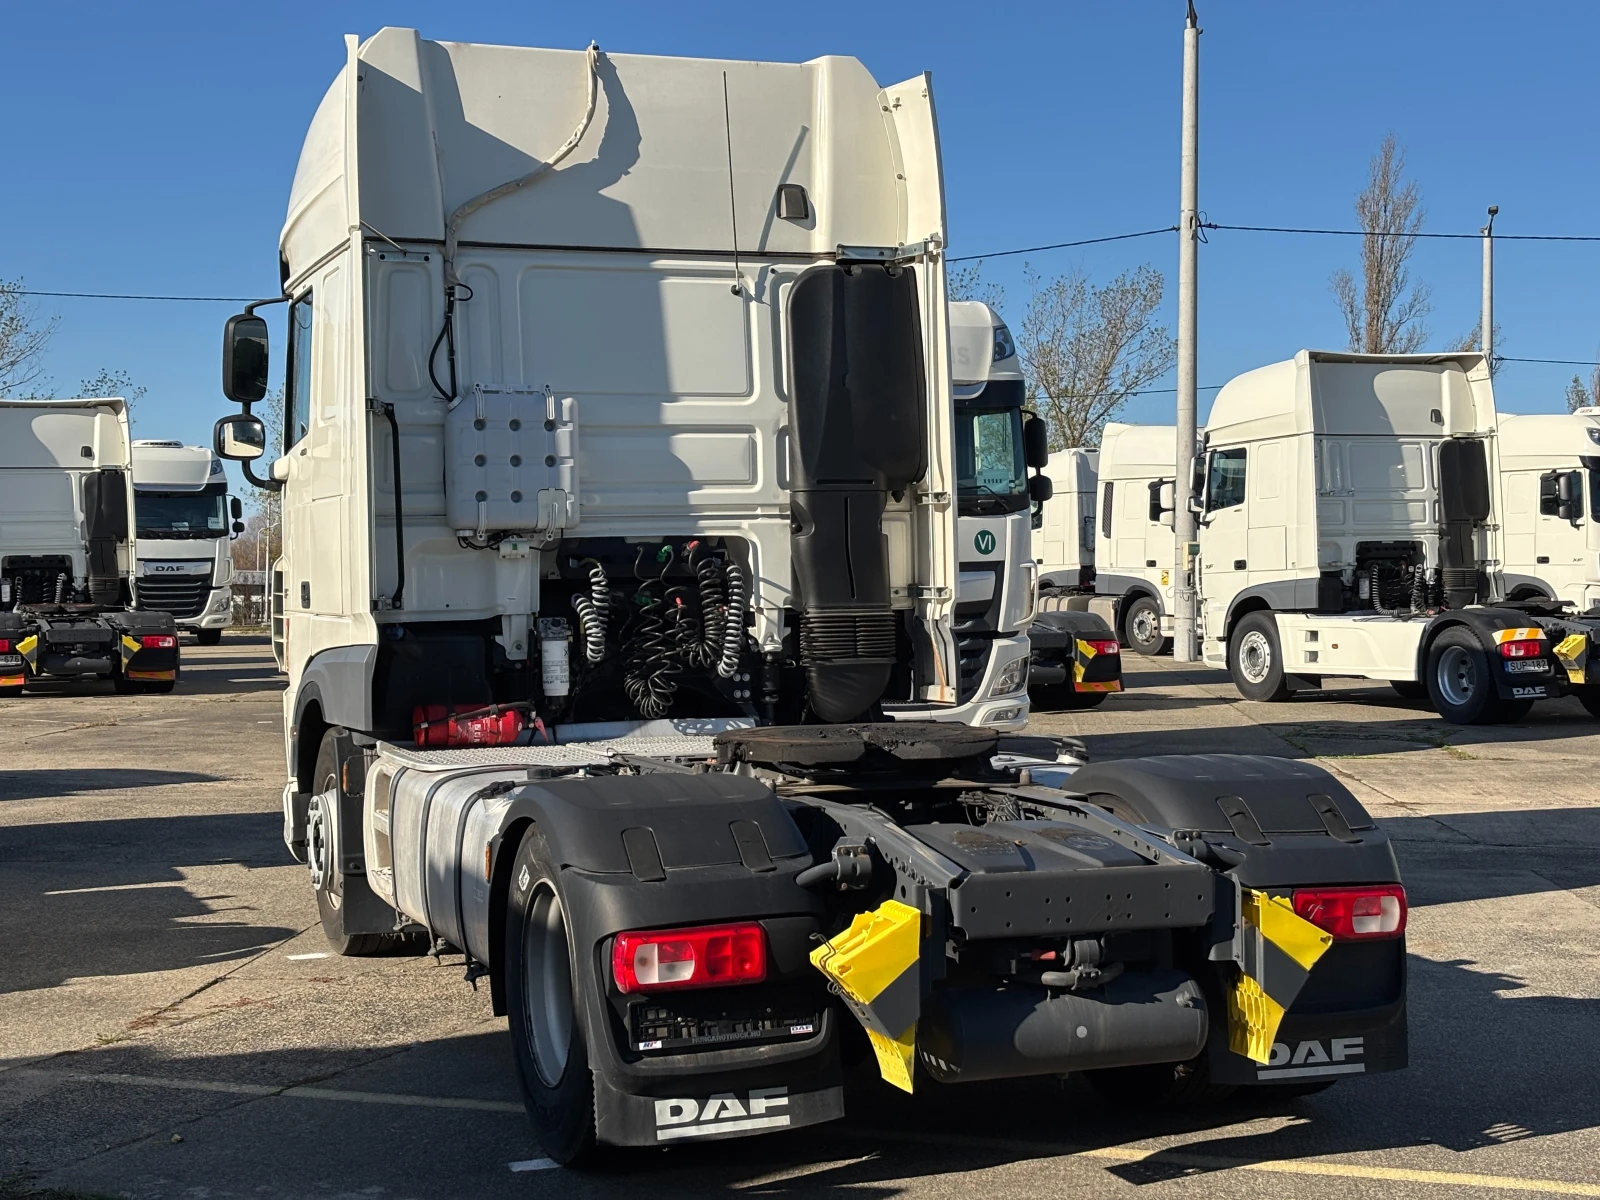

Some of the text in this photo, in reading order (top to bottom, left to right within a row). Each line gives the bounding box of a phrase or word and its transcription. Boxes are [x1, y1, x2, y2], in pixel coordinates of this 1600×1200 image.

[977, 534, 992, 551] VI
[1510, 660, 1547, 671] SUP-182
[1512, 686, 1546, 695] DAF
[1255, 1036, 1364, 1067] DAF
[654, 1086, 789, 1126] DAF
